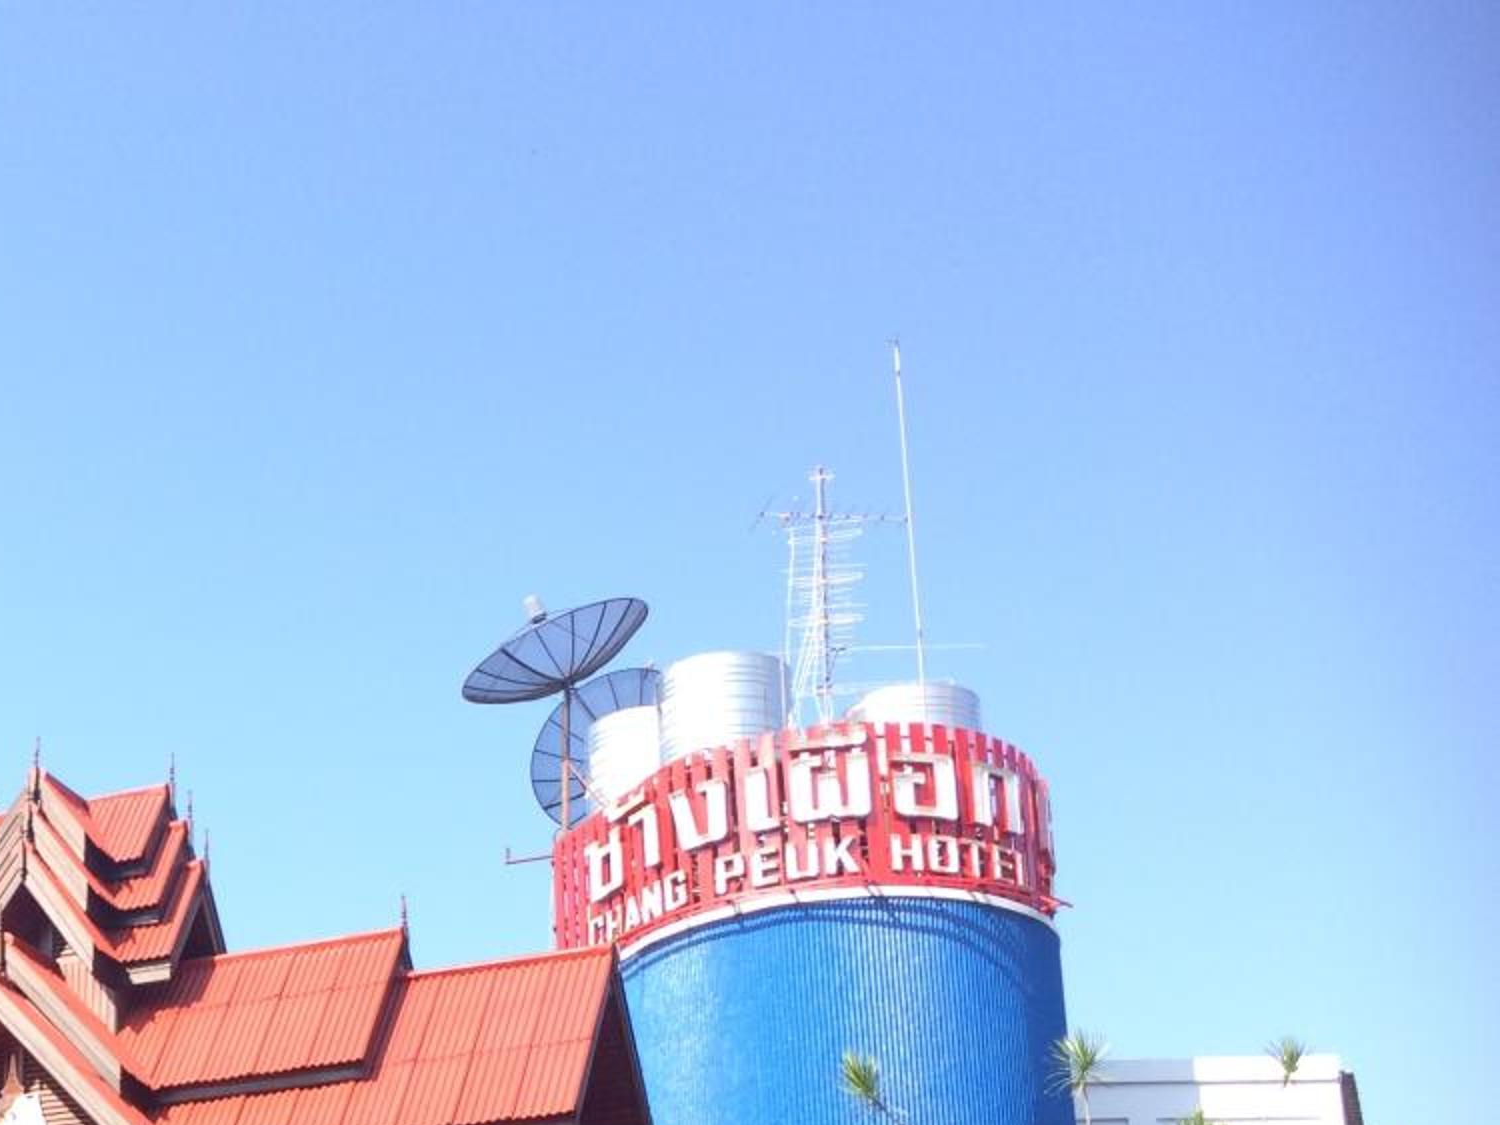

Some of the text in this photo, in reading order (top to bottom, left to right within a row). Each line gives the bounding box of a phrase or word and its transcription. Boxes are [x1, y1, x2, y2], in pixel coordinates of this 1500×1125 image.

[587, 833, 1028, 945] CHANG PEUK HOTEL
